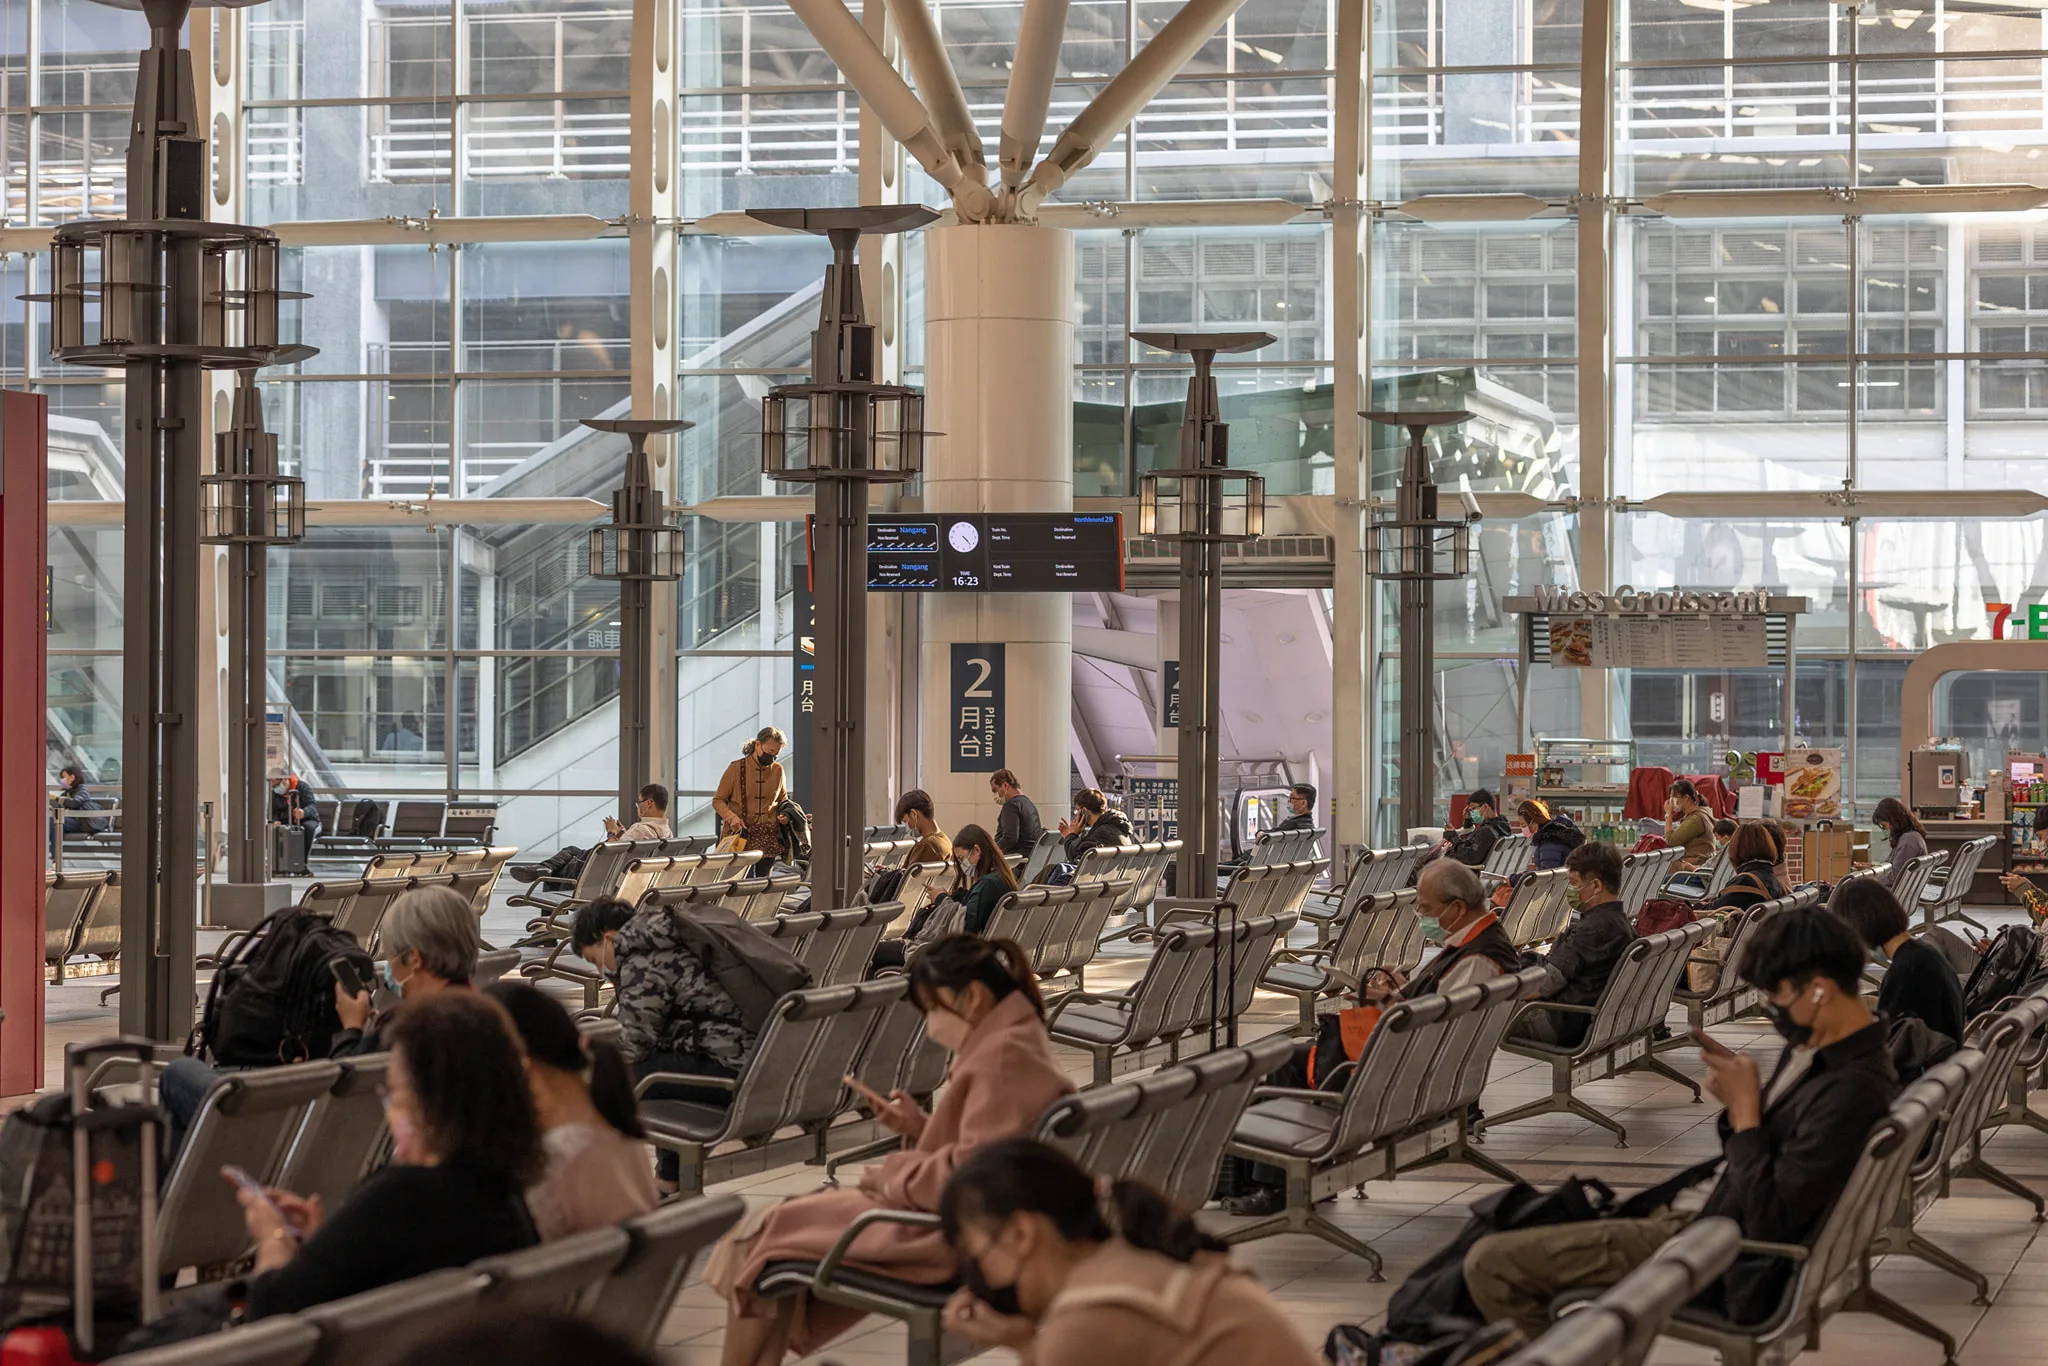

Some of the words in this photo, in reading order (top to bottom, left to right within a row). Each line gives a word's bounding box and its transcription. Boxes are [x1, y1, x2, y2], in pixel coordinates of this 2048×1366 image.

[901, 563, 929, 571] Nangang
[952, 577, 979, 586] 16:23
[1534, 584, 1605, 612] Miss
[1614, 584, 1769, 612] Croissant
[964, 658, 992, 697] 2
[801, 681, 814, 712] 月台
[960, 706, 981, 758] 月台
[985, 707, 995, 758] Platform
